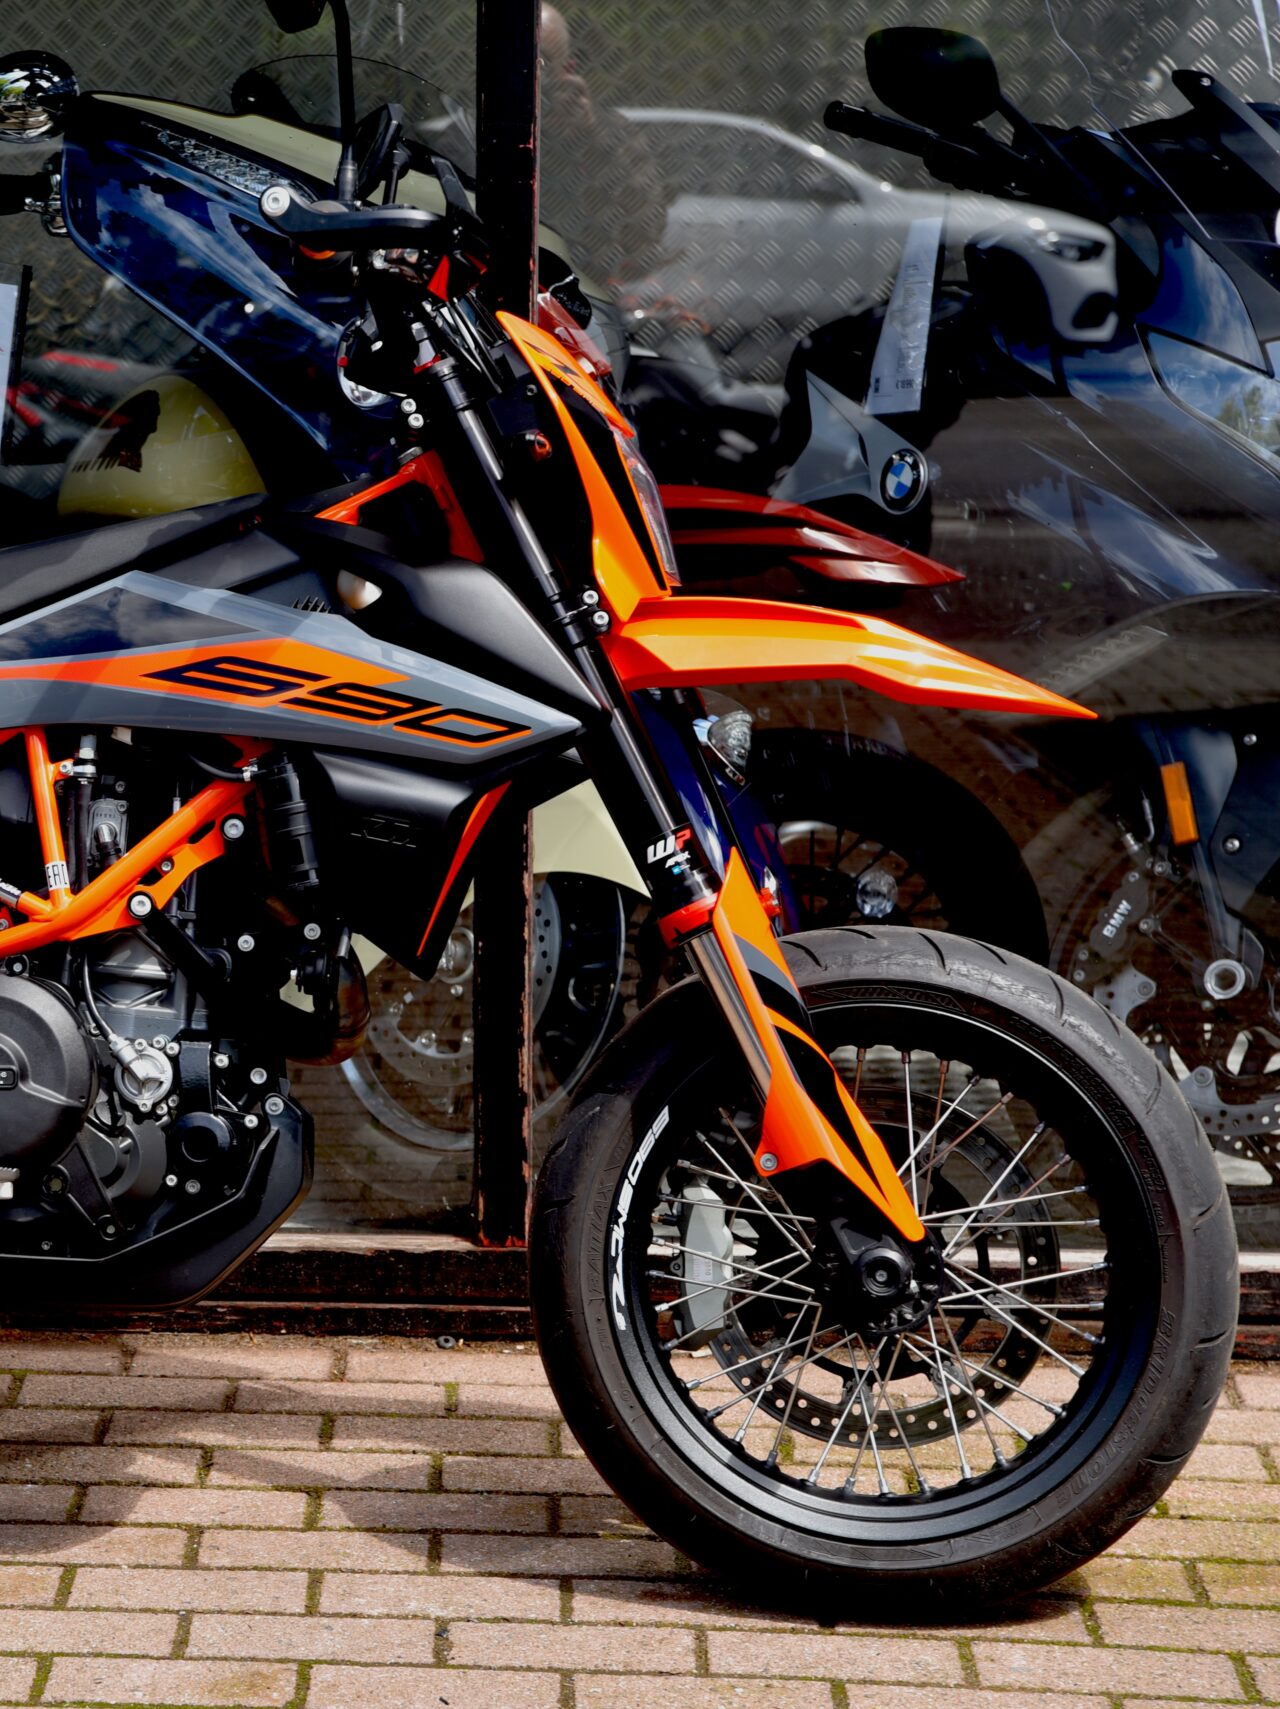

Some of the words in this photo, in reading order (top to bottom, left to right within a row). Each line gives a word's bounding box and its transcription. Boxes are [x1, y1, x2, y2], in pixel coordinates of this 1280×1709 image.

[138, 655, 533, 749] 690
[646, 828, 692, 865] WP
[1102, 899, 1132, 938] BMW
